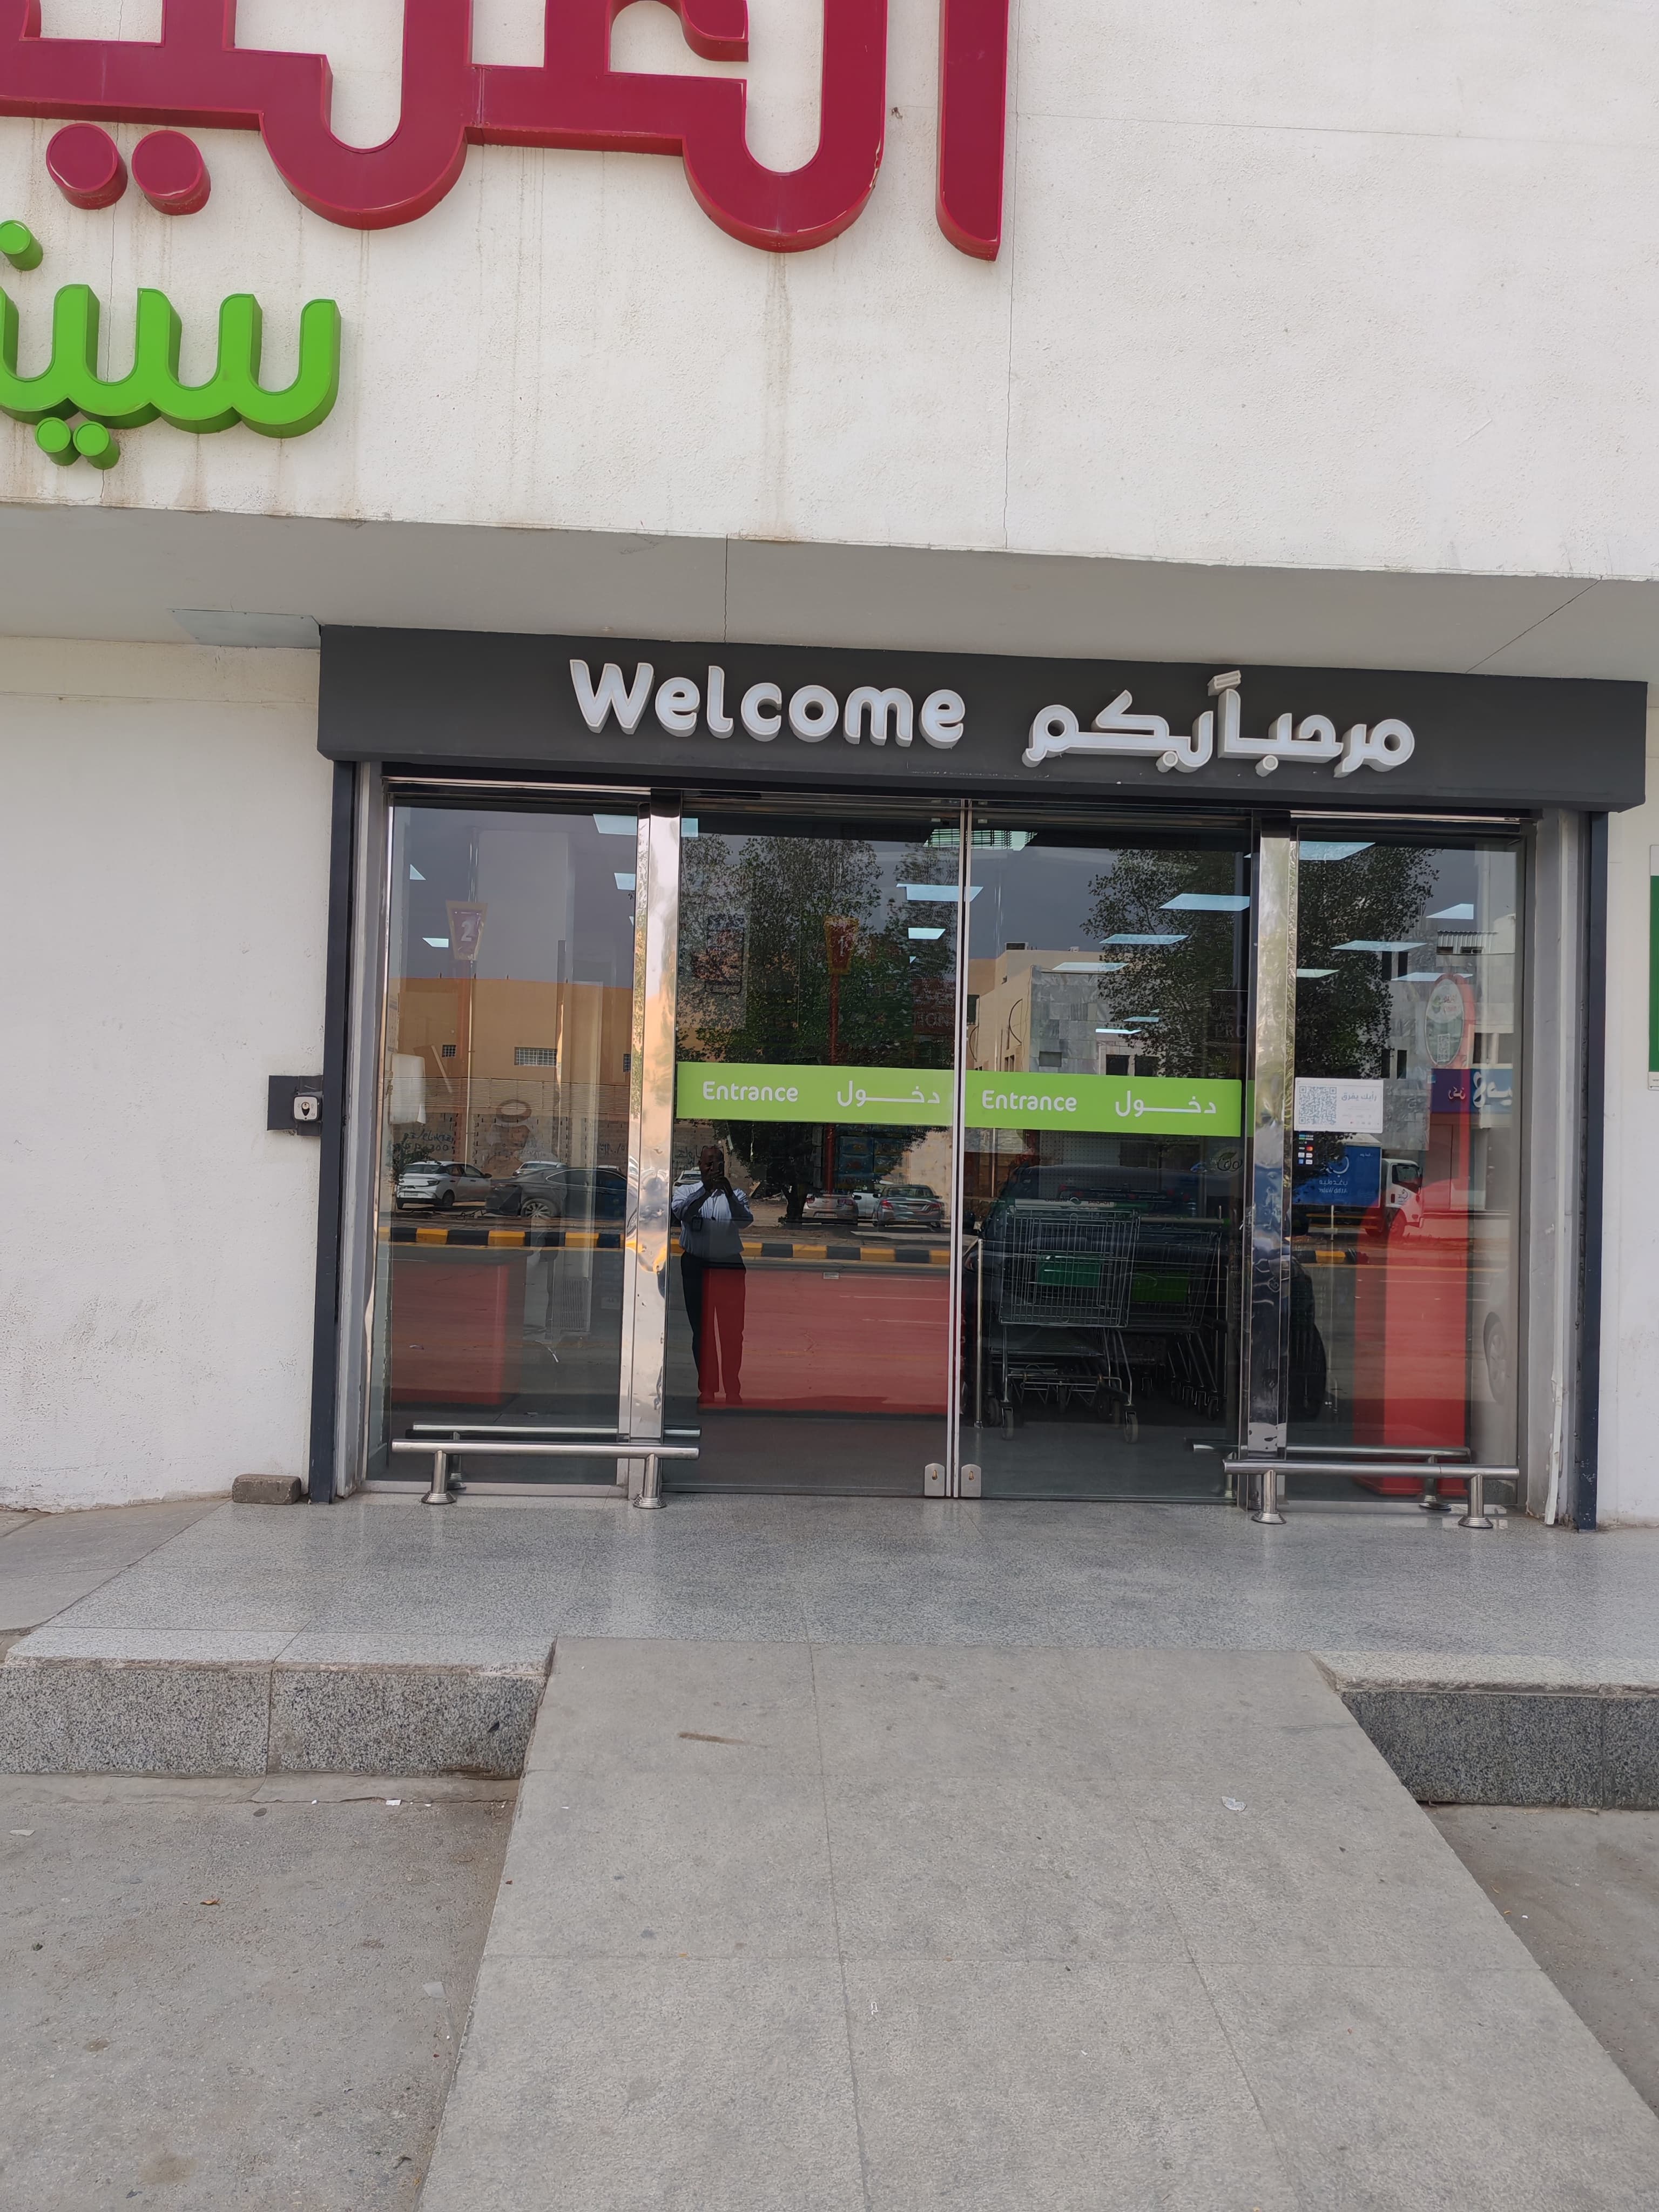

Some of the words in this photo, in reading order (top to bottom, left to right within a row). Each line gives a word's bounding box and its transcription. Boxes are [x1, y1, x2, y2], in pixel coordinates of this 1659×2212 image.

[569, 659, 966, 750] Welcome
[1021, 689, 1214, 773] بكم
[703, 1081, 799, 1102] Entrance
[837, 1080, 940, 1107] دخول
[981, 1090, 1077, 1112] Entrance
[1115, 1090, 1217, 1117] دخول
[1341, 1092, 1359, 1101] يفرق
